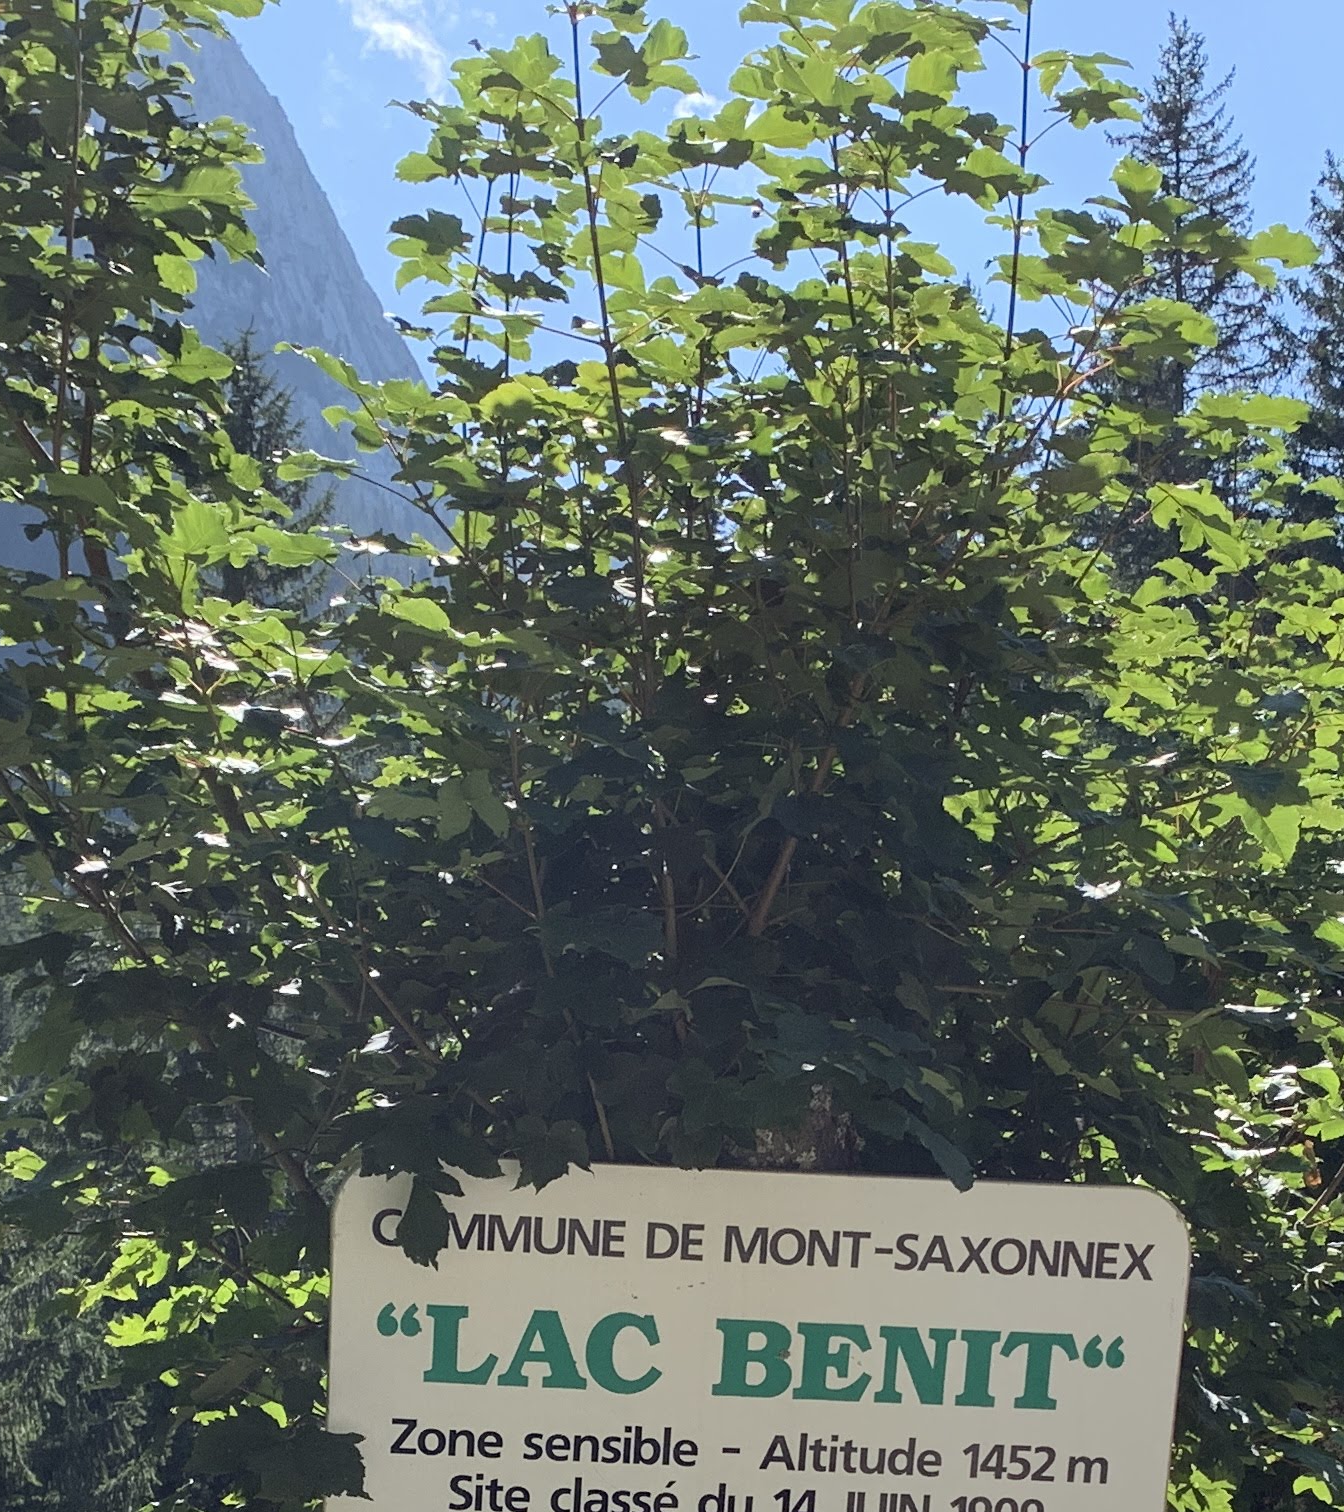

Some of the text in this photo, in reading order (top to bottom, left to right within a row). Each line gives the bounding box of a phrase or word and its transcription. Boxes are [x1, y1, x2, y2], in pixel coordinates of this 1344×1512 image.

[371, 1207, 1156, 1281] CMMUNE DE MONT-SAXONNEX
[389, 1417, 504, 1459] Zone
[522, 1425, 699, 1468] sensible
[758, 1432, 942, 1478] Altitude
[962, 1443, 1057, 1483] 1452
[1066, 1455, 1109, 1485] m
